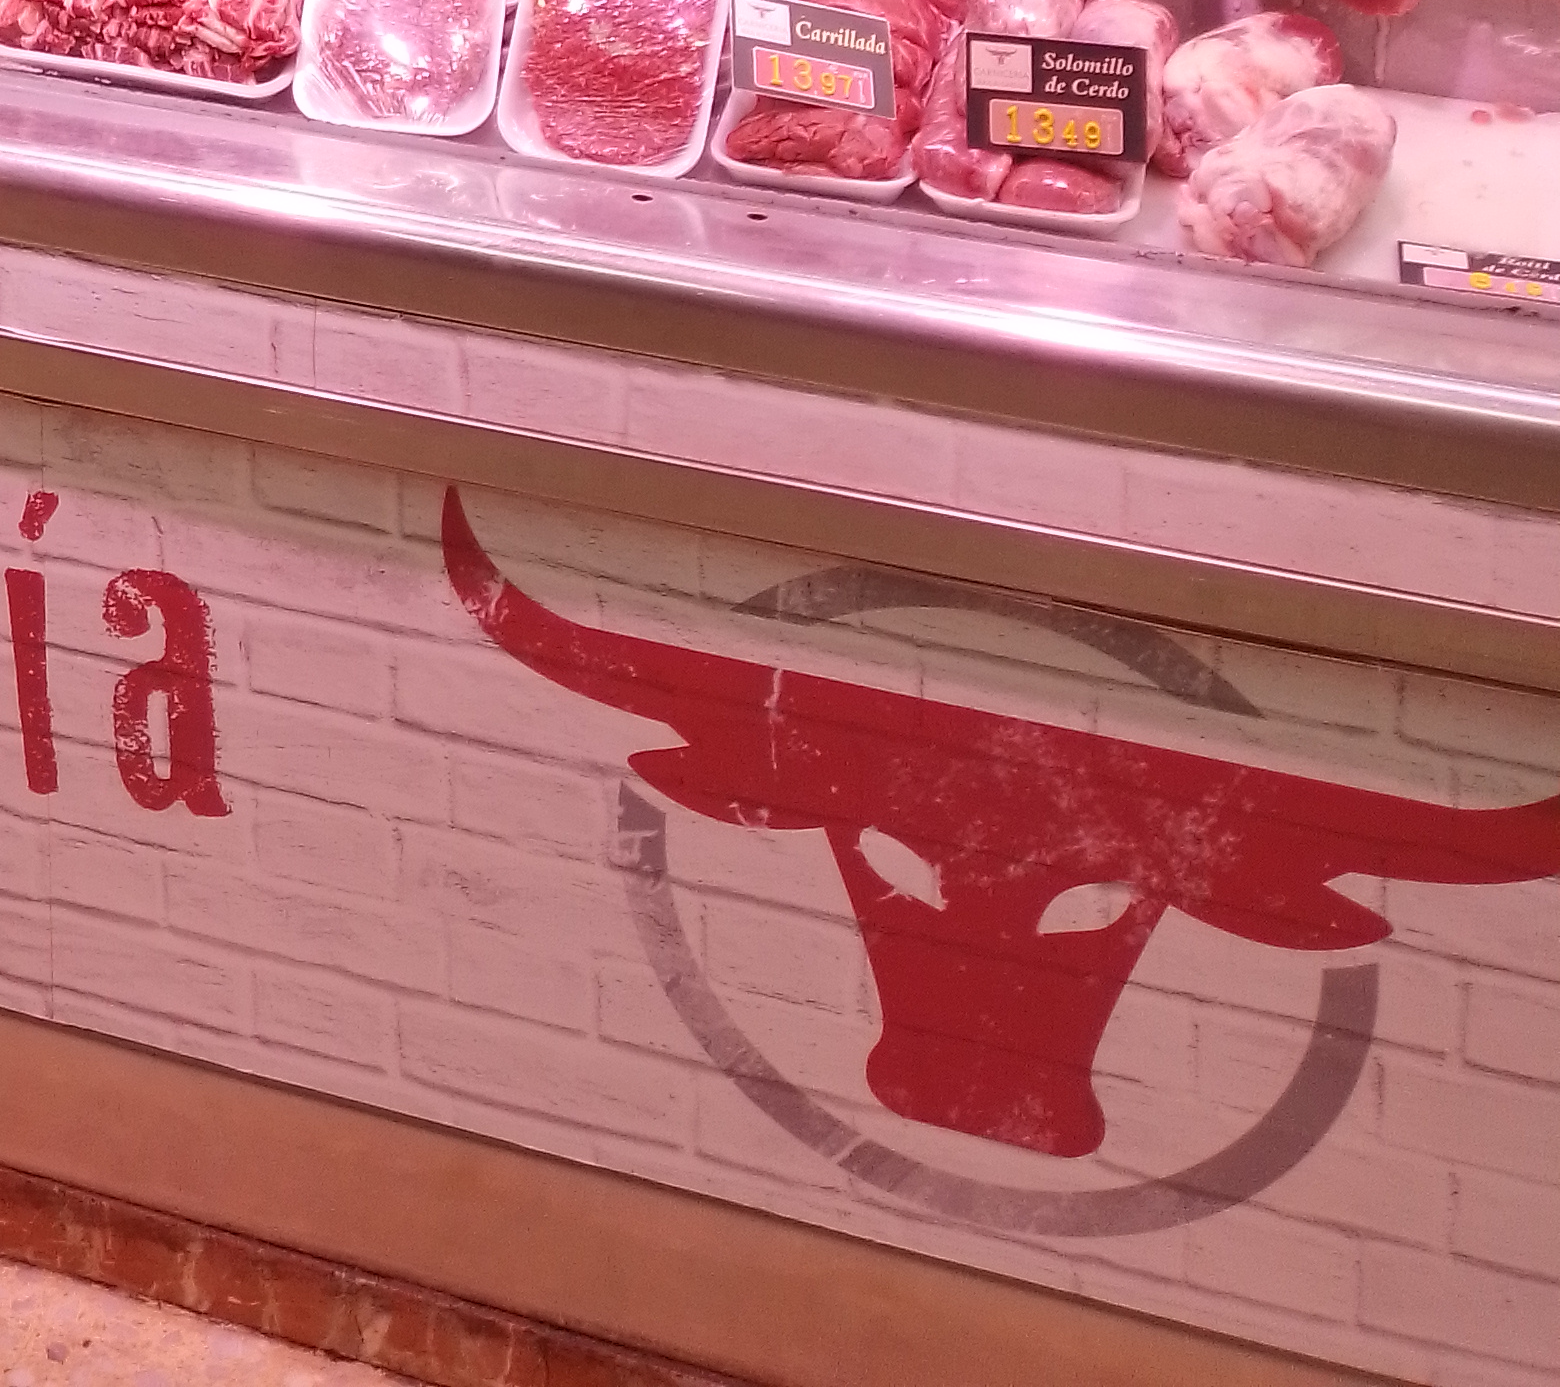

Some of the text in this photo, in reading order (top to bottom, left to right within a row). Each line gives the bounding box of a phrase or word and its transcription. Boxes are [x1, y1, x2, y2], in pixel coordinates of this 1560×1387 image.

[795, 21, 887, 55] Carrillada
[1041, 51, 1134, 77] Solomillo
[1044, 76, 1130, 100] de Cerdo
